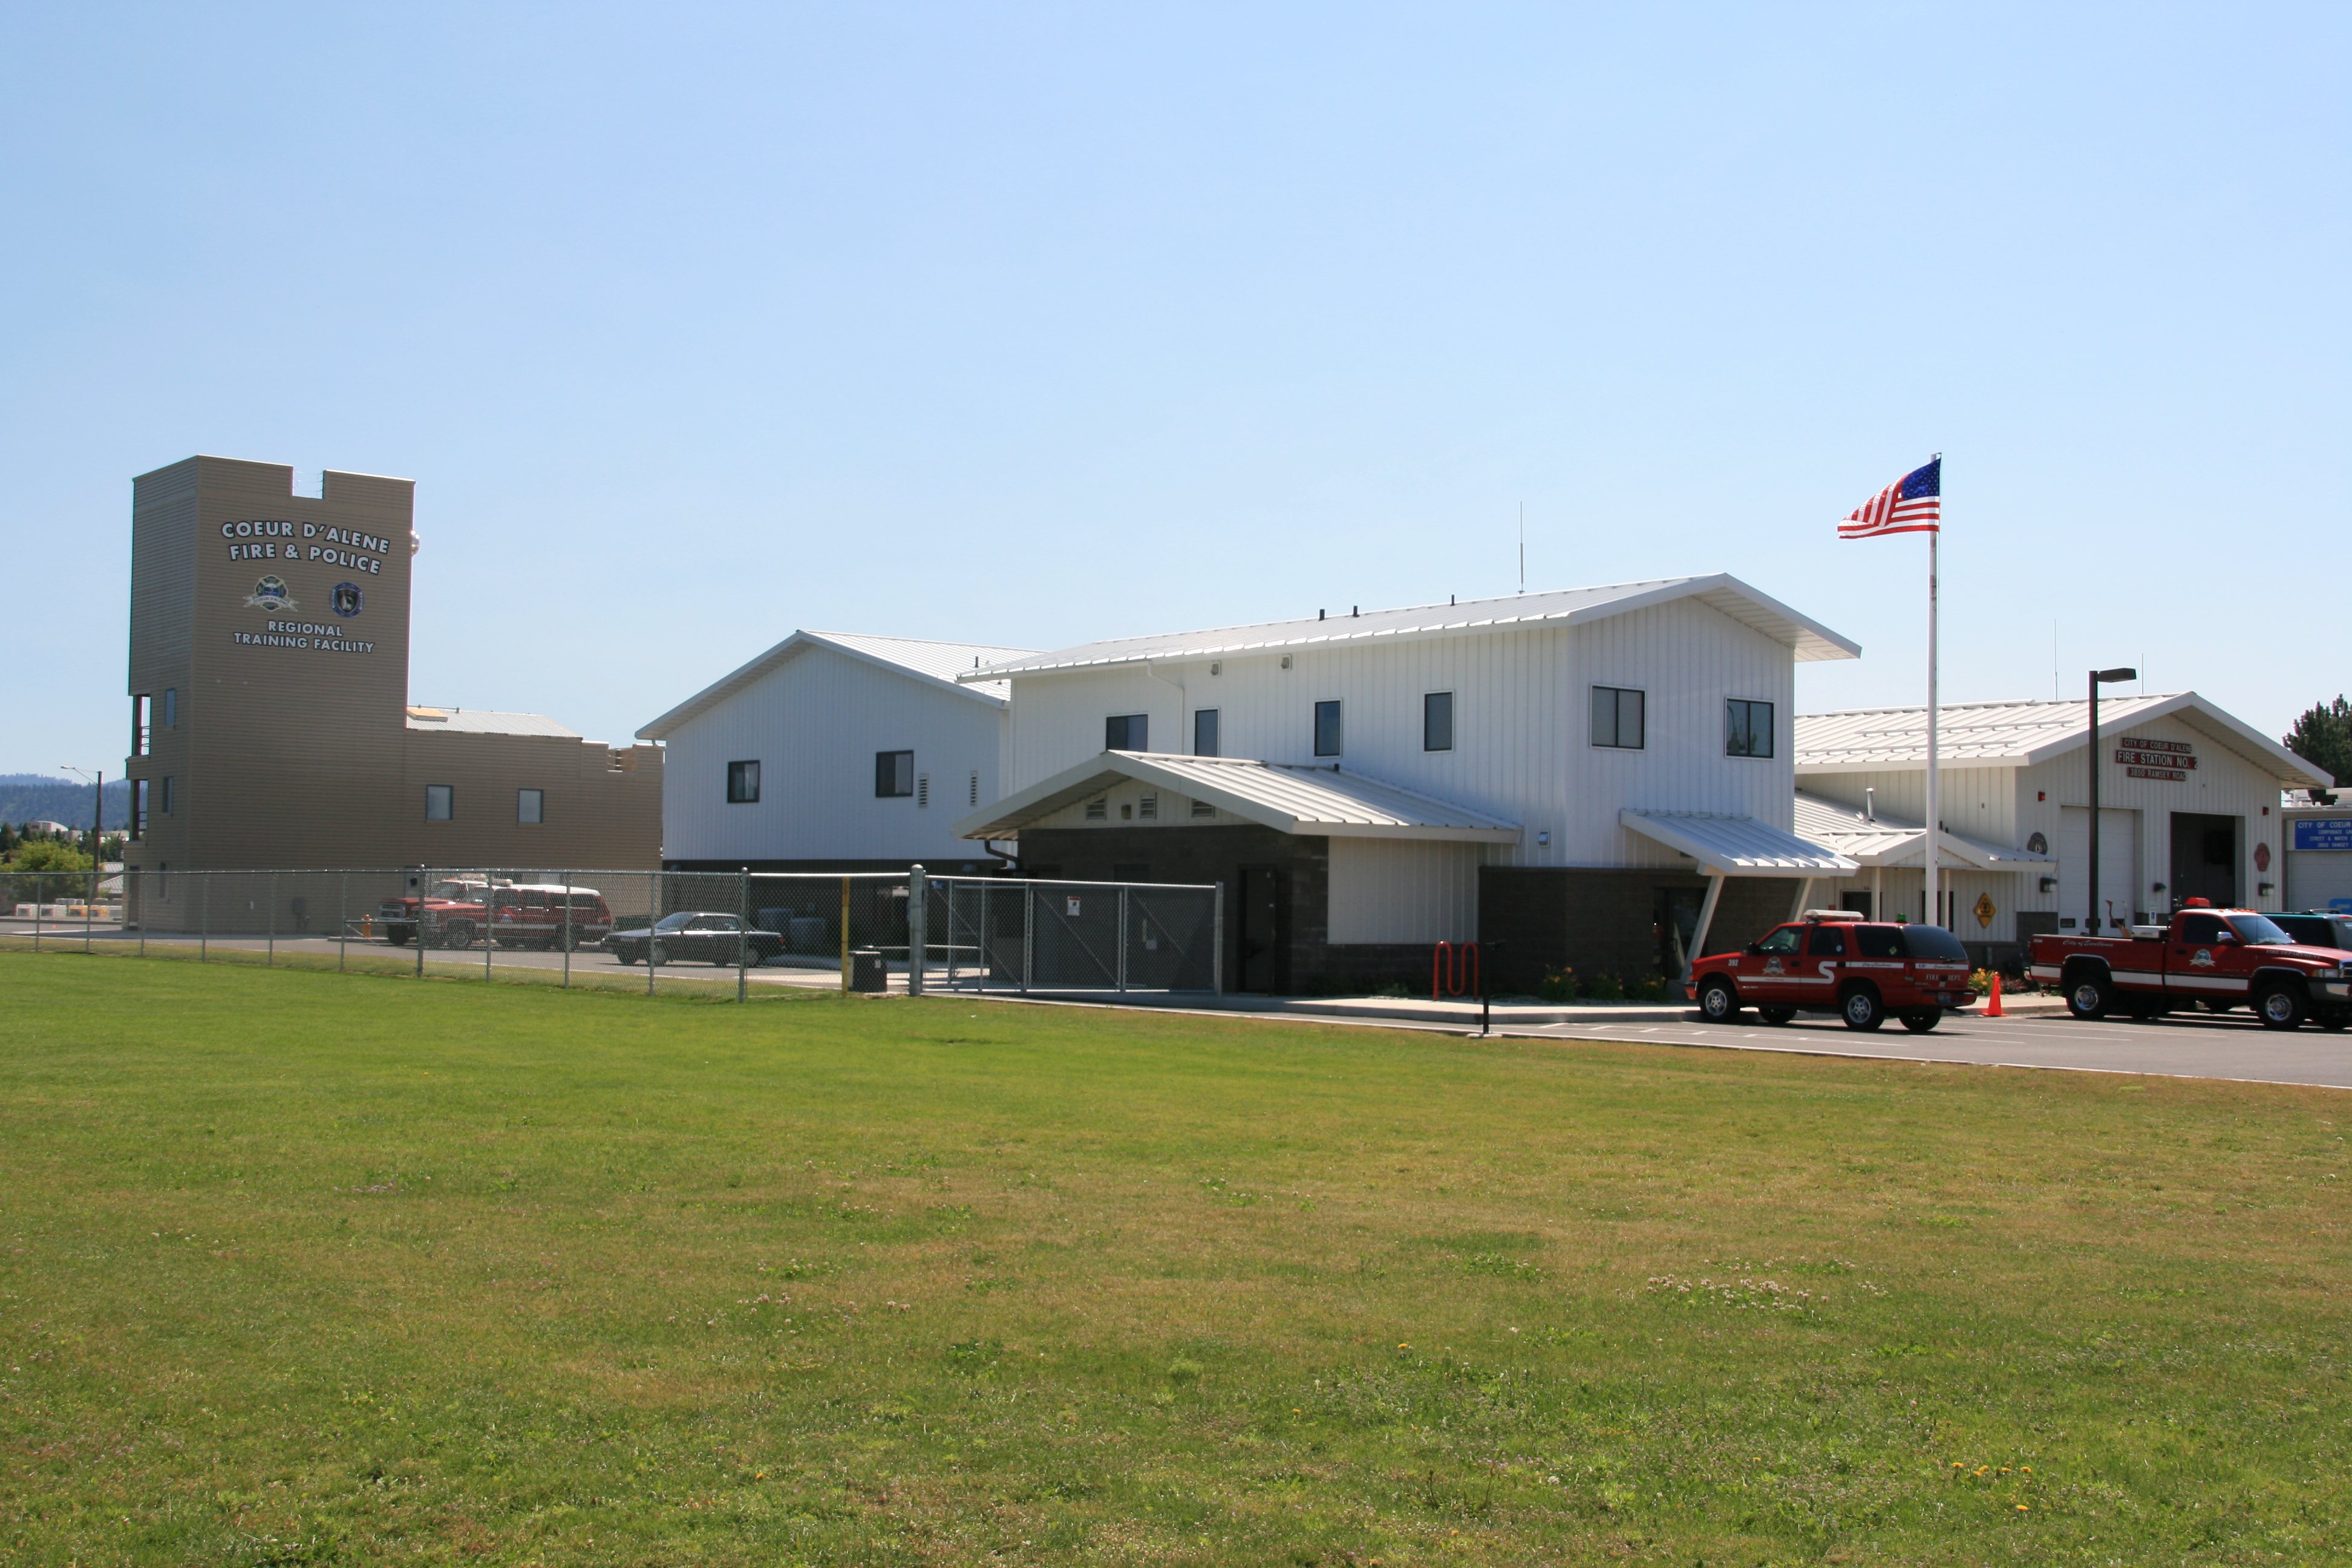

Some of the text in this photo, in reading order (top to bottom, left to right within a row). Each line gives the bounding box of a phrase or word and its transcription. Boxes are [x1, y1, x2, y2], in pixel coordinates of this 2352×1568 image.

[221, 521, 390, 555] COEUR D'ALENE
[229, 543, 381, 575] FIRE & POLICE
[268, 620, 344, 637] REGIONAL
[234, 632, 375, 653] TRAINING FACILITY
[2124, 739, 2137, 747] CITY
[2149, 741, 2169, 750] COEUR
[2171, 743, 2193, 753] D'ALENE
[2117, 751, 2198, 769] FIRE STATION NO. 2
[2130, 768, 2186, 780] 3850 RAMSEY ROAD
[2280, 950, 2321, 959] DEPARTMENT
